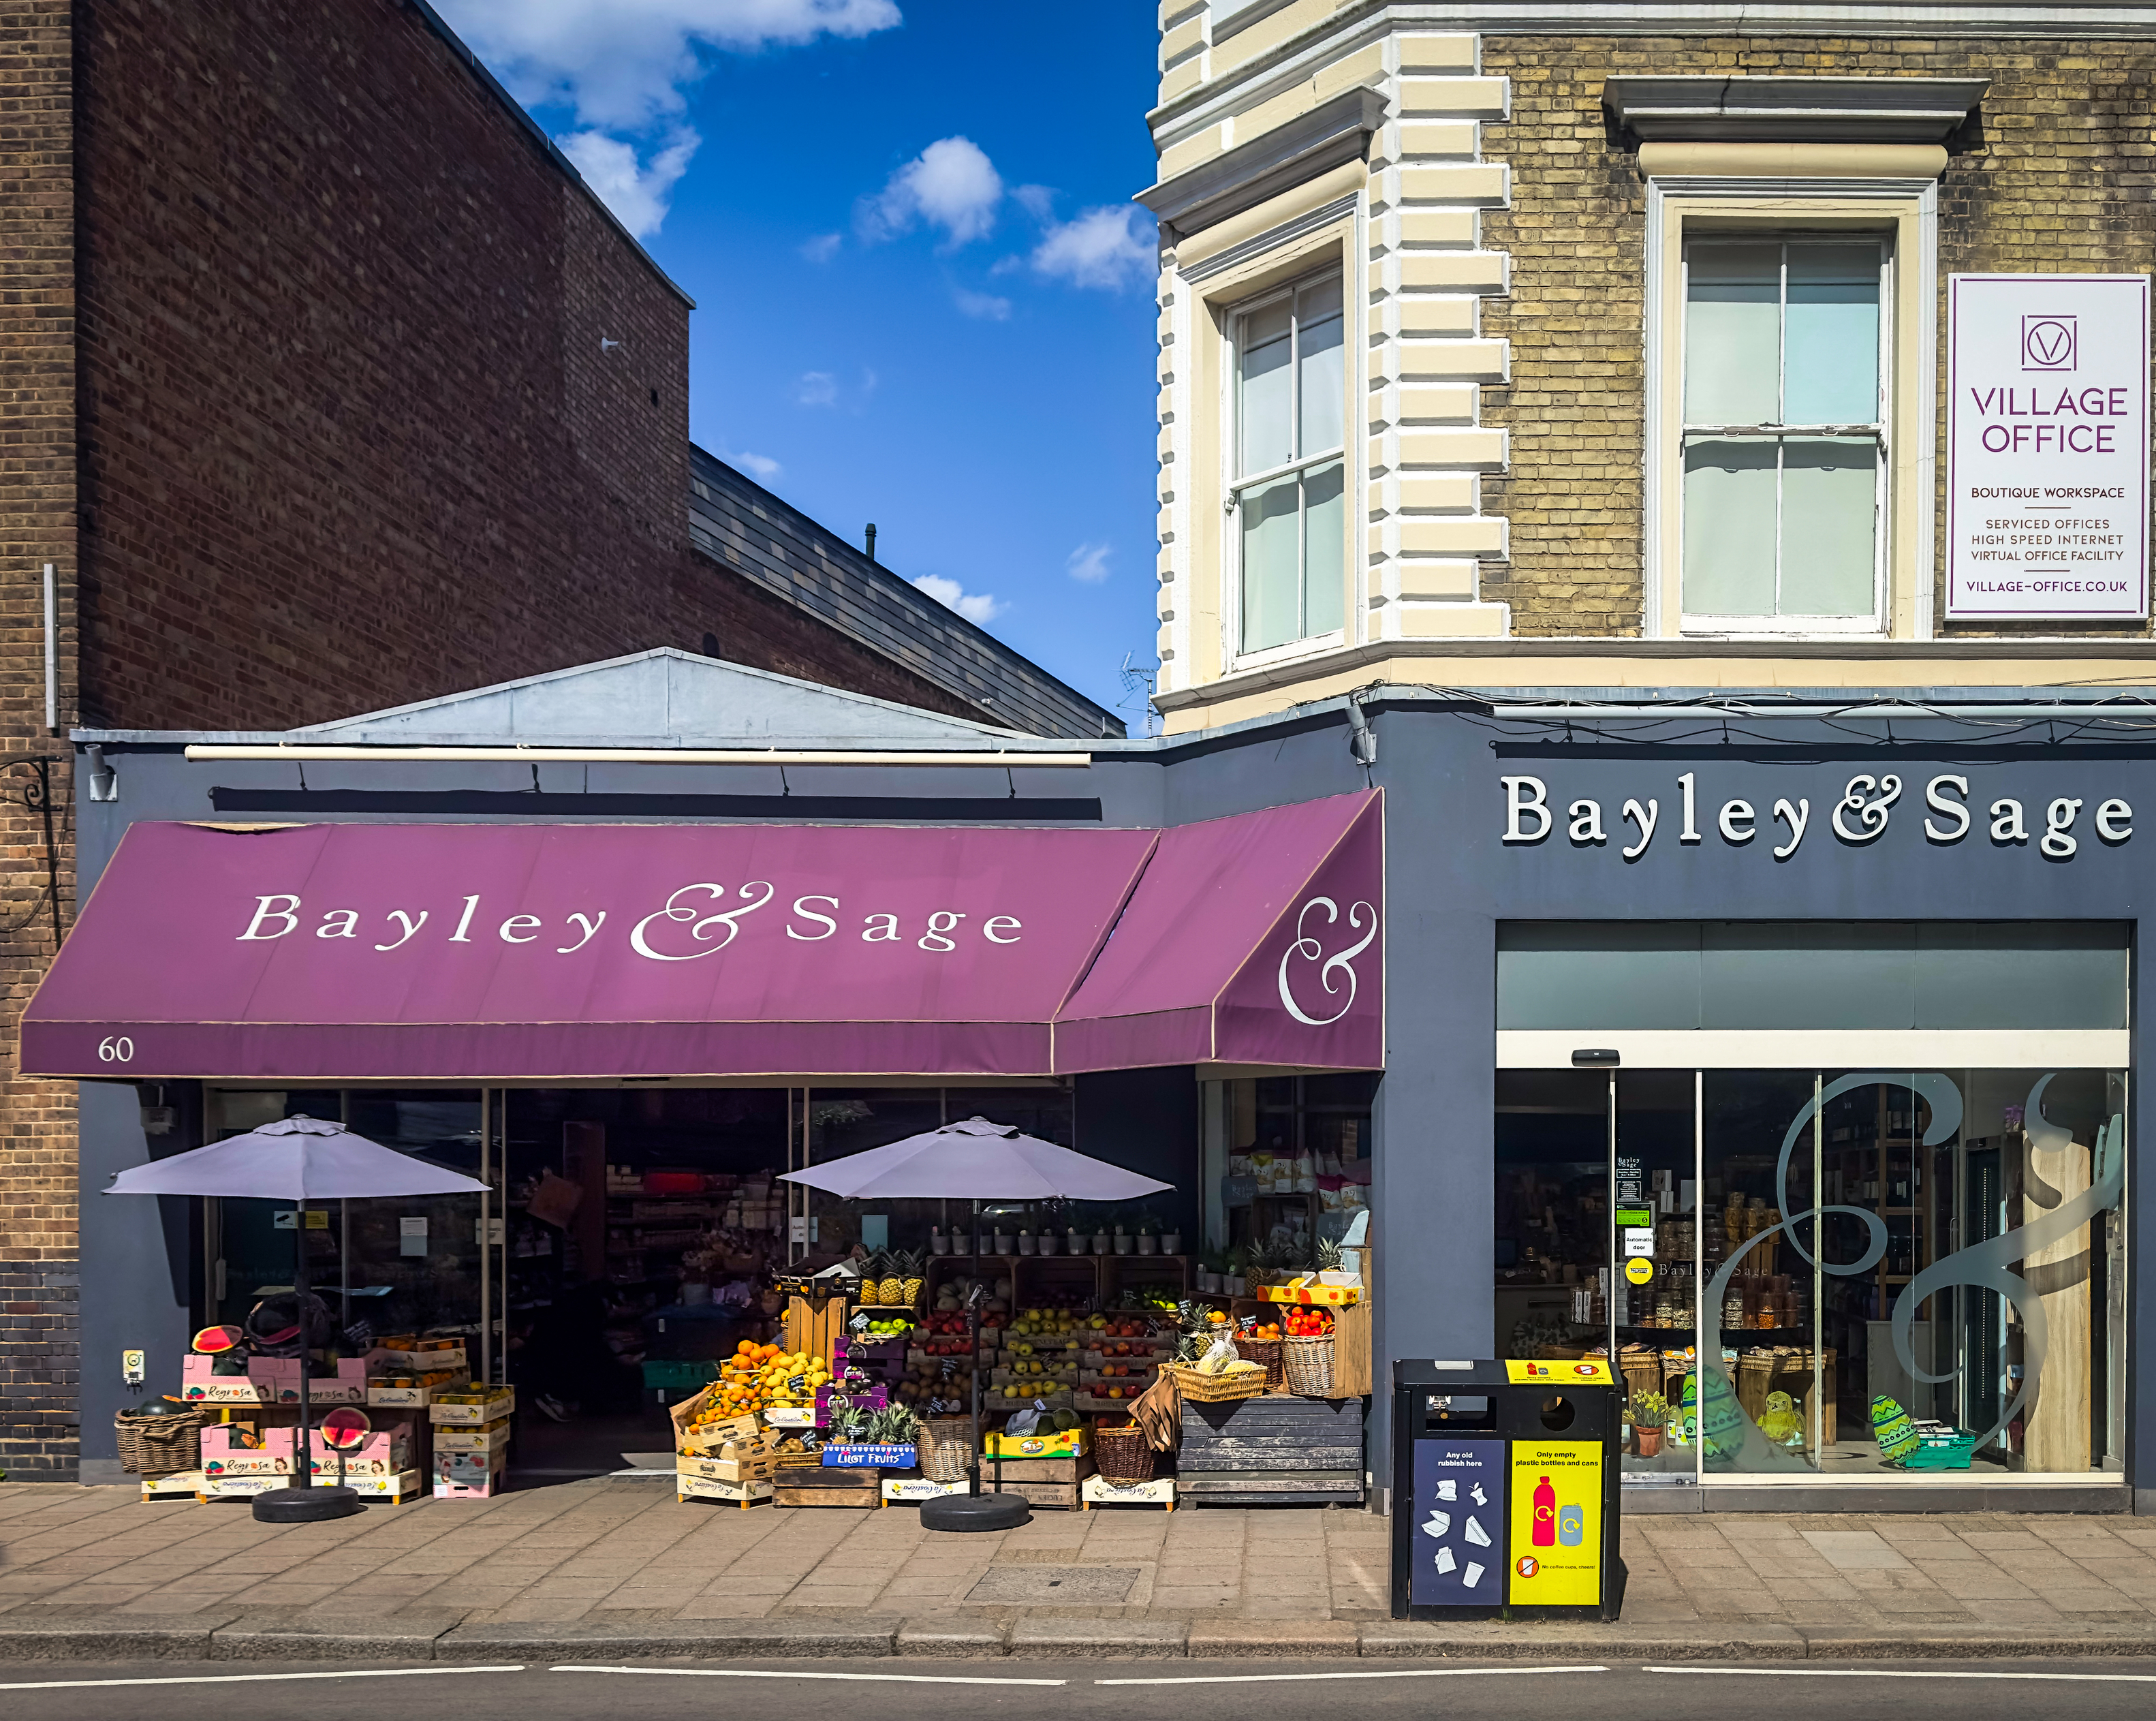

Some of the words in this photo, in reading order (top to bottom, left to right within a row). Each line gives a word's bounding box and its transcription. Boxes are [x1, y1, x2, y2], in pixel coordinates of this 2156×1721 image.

[1971, 387, 2128, 416] VILLAGE
[1982, 424, 2116, 452] OFFICE
[1971, 487, 2040, 499] BOUTIQUE
[2044, 487, 2125, 499] WORKSPACE
[1986, 519, 2050, 529] SERVICED
[2055, 519, 2110, 529] OFFICES
[1971, 535, 2006, 545] HIGH
[2010, 535, 2052, 545] SPEED
[2058, 535, 2125, 545] INTERNET
[1971, 551, 2021, 561] VIRTUAL
[2025, 551, 2067, 561] OFFICE
[2071, 551, 2124, 561] FACILITY
[1967, 580, 2128, 592] VILLAGE-OFFICE.CO.UK
[1499, 772, 1810, 858] Bayley
[1832, 774, 1902, 842] &
[1924, 774, 2134, 857] Sage
[235, 893, 606, 954] Bayley
[630, 880, 775, 961] &
[786, 895, 1022, 952] Sage
[1278, 896, 1378, 1025] &
[97, 1035, 135, 1063] 60
[1659, 1263, 1712, 1277] Bayly
[308, 1391, 344, 1402] egrosa
[1446, 1451, 1460, 1459] Any
[1516, 1459, 1540, 1468] plastic
